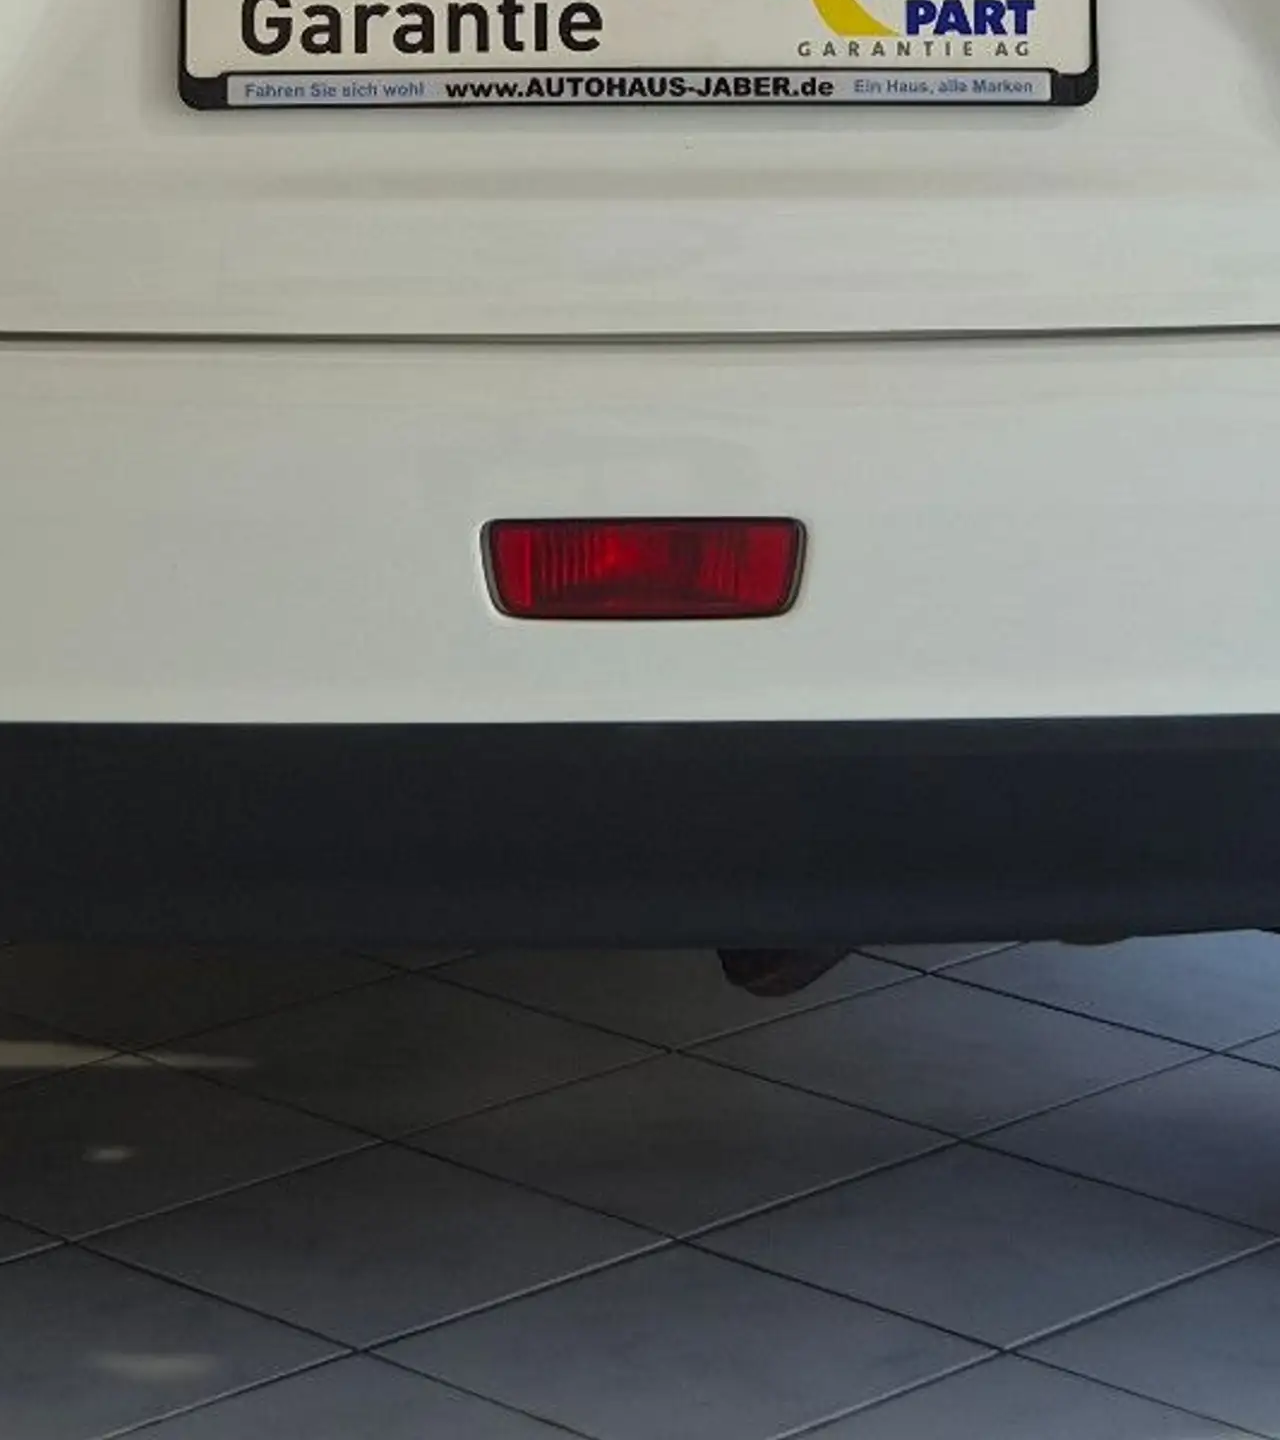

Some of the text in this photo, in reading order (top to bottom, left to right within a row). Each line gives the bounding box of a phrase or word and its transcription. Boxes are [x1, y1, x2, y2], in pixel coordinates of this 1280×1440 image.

[797, 41, 1029, 56] GARANTIE AG
[245, 82, 424, 97] Fahren Sie sich wohl
[445, 77, 834, 97] www.AUTOHAUS-JABER.de
[854, 78, 1033, 95] Ein Haus, alle Marken
